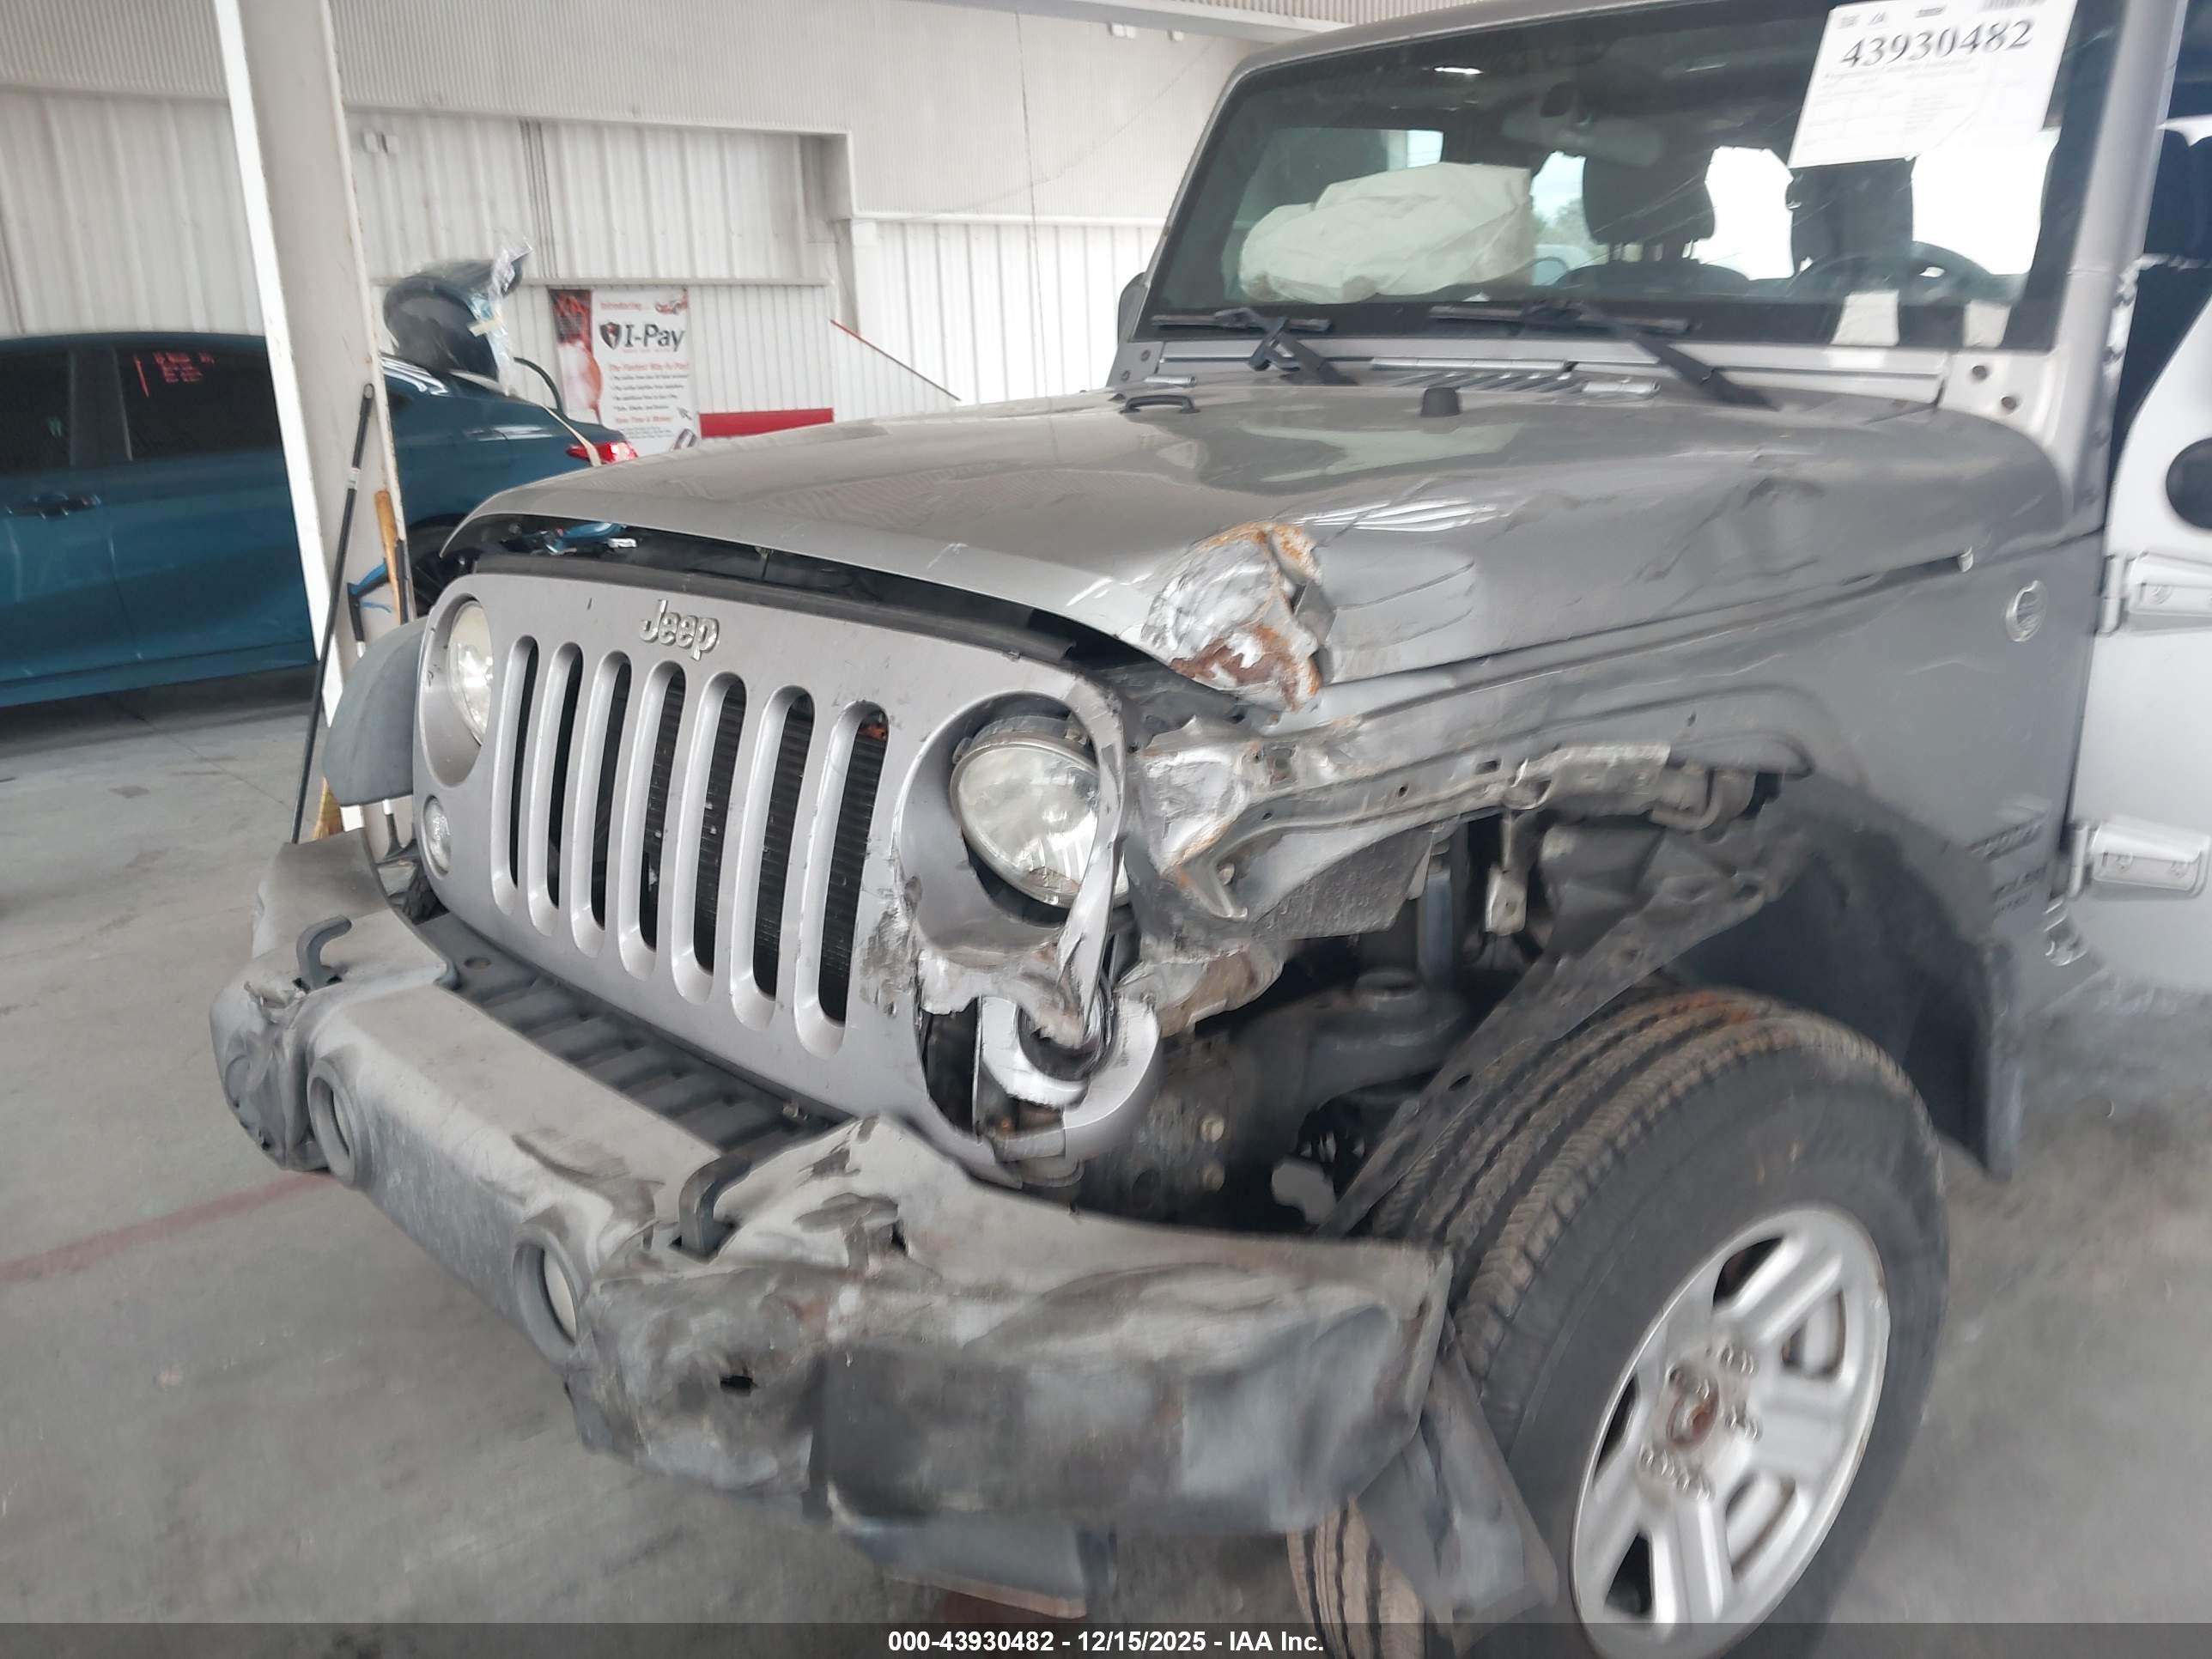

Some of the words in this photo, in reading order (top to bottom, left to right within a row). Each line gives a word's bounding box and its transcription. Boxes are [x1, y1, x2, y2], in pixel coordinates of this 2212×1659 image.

[1842, 20, 2034, 68] 43930482
[624, 323, 685, 352] I-Pay
[640, 599, 720, 661] Jeep
